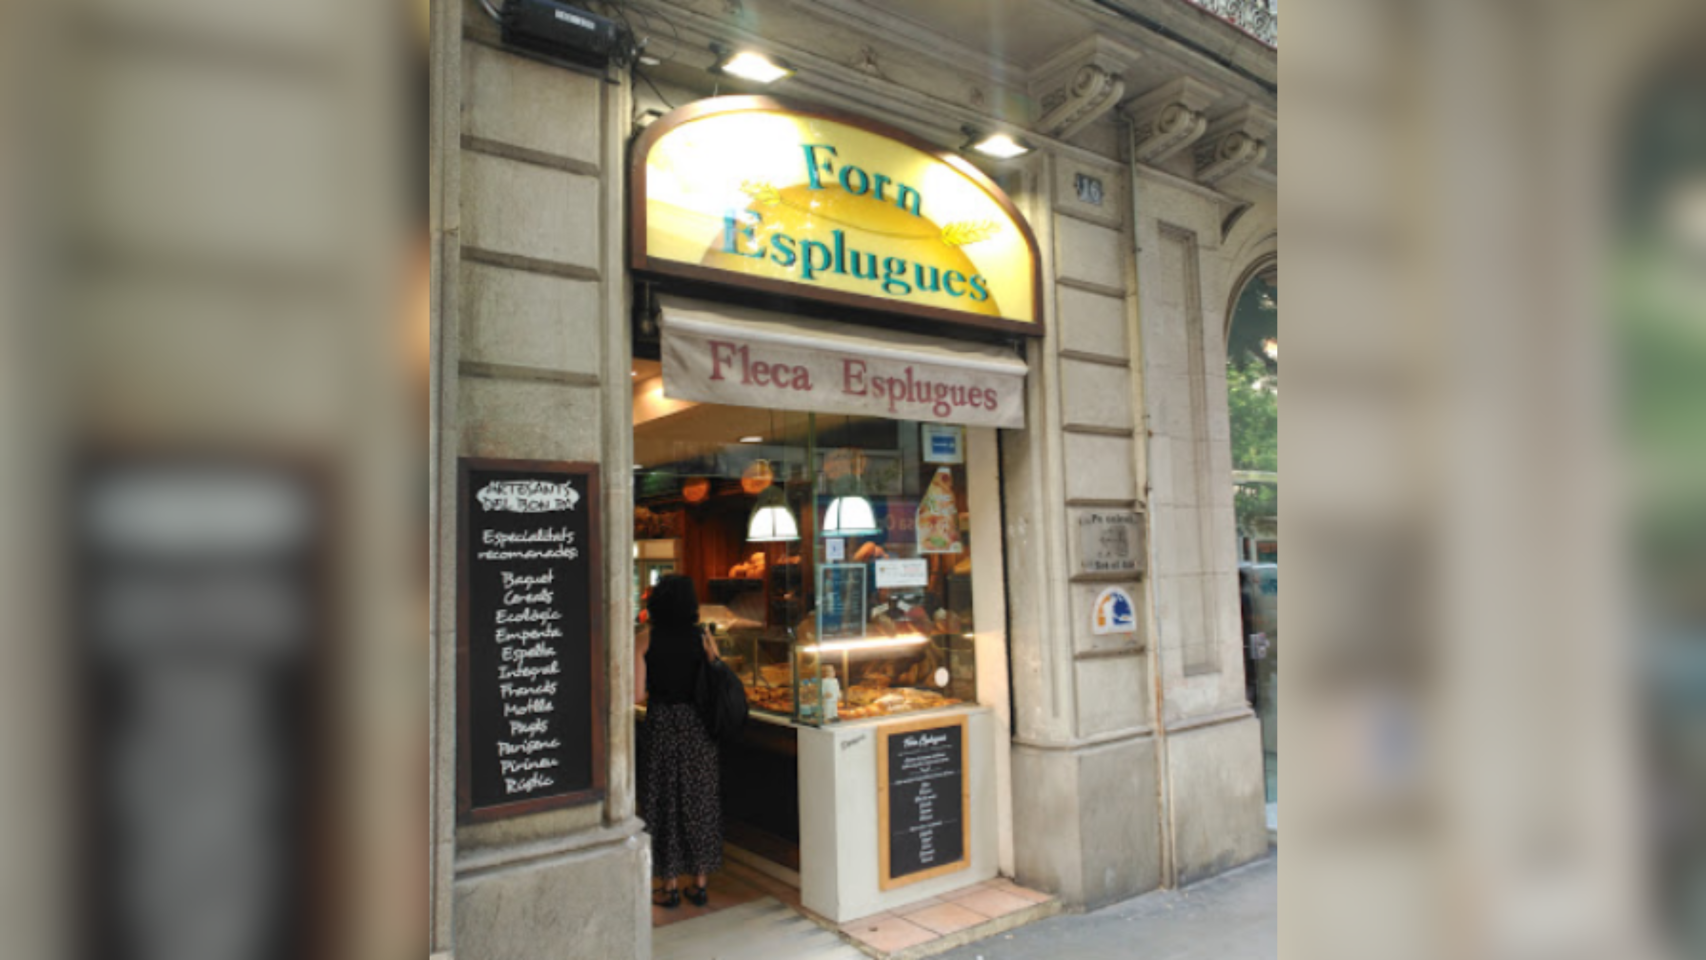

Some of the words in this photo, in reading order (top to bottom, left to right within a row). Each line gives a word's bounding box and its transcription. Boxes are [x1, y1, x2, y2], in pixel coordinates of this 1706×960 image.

[799, 143, 922, 217] Forn
[722, 207, 989, 302] Esplugues
[707, 340, 813, 391] Fleca
[841, 358, 999, 418] Esplugues
[482, 527, 576, 549] Especialitats
